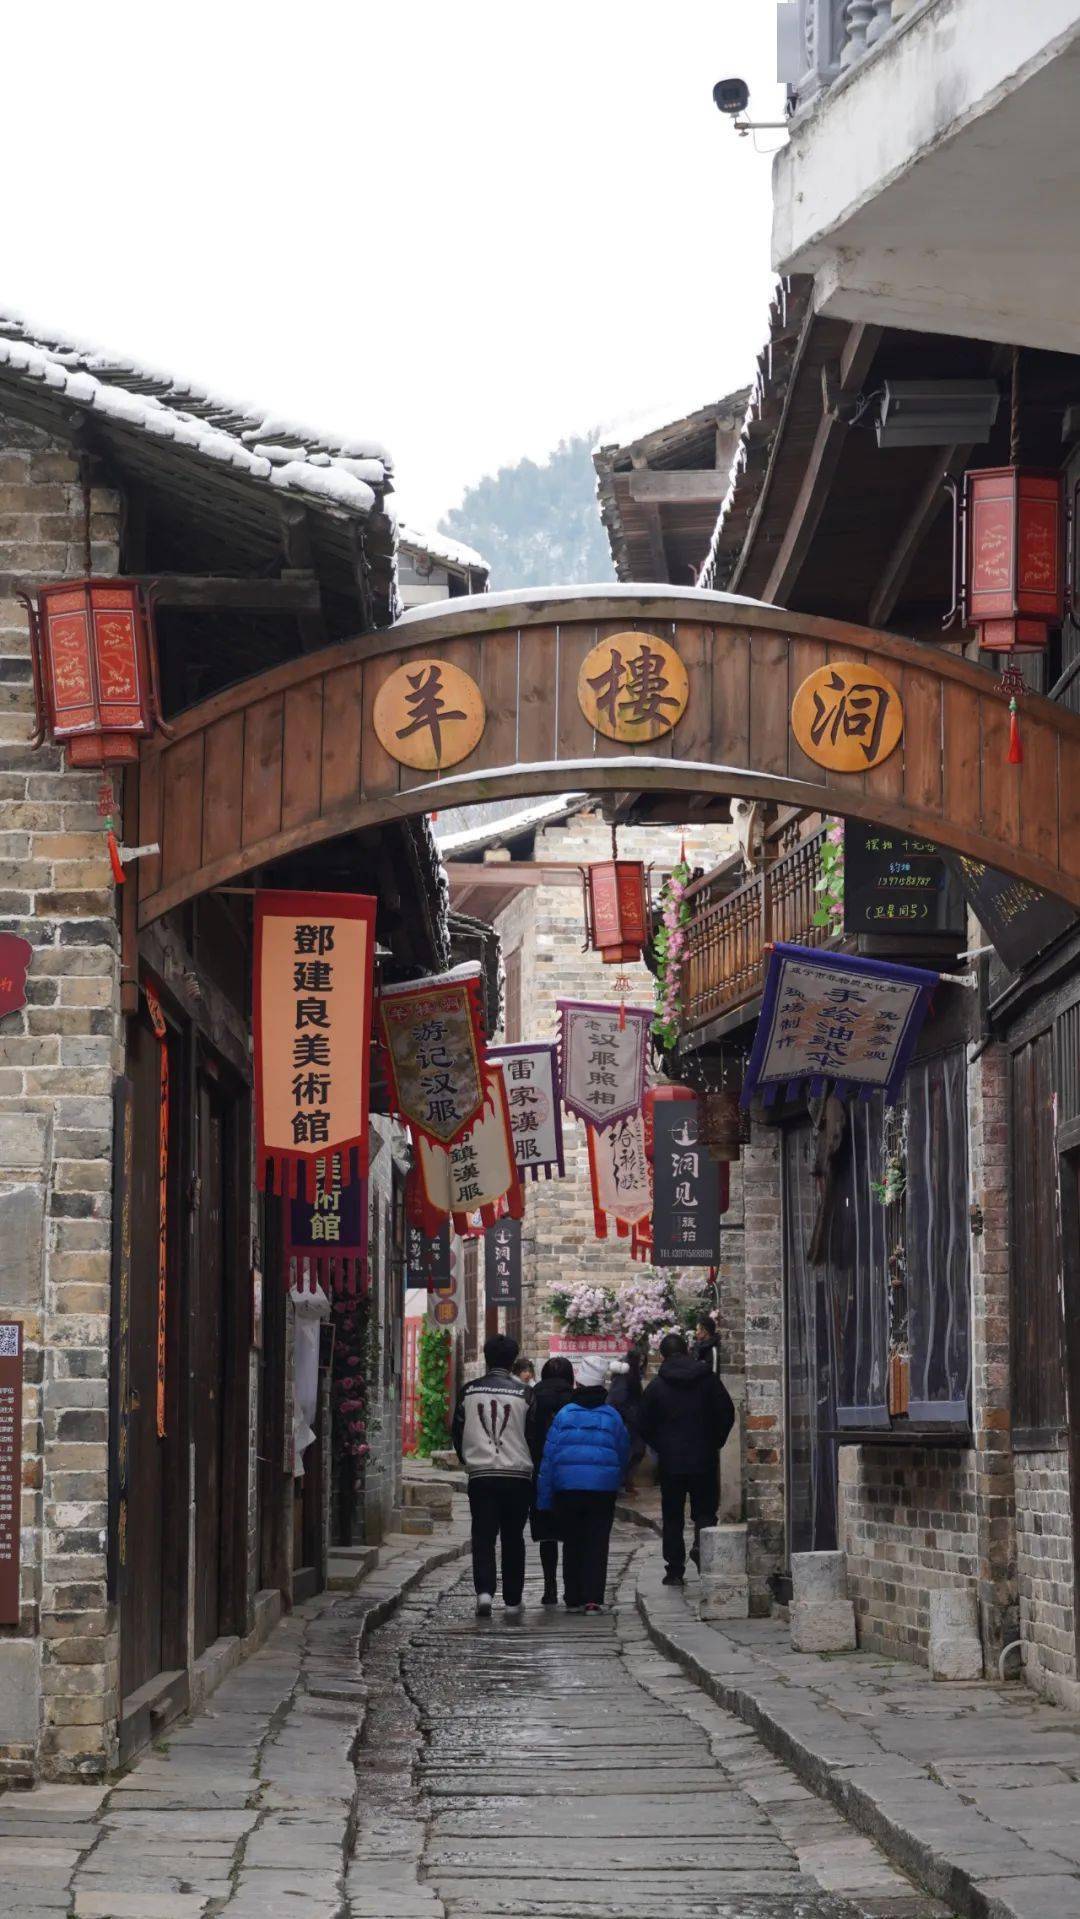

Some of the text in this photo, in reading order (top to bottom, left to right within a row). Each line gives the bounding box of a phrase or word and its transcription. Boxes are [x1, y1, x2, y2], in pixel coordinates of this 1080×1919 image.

[291, 925, 335, 1144] 鄧建良美術館
[412, 1020, 462, 1122] 游记汉服
[508, 1060, 542, 1160] 雷家漢服
[671, 1152, 698, 1207] 洞见
